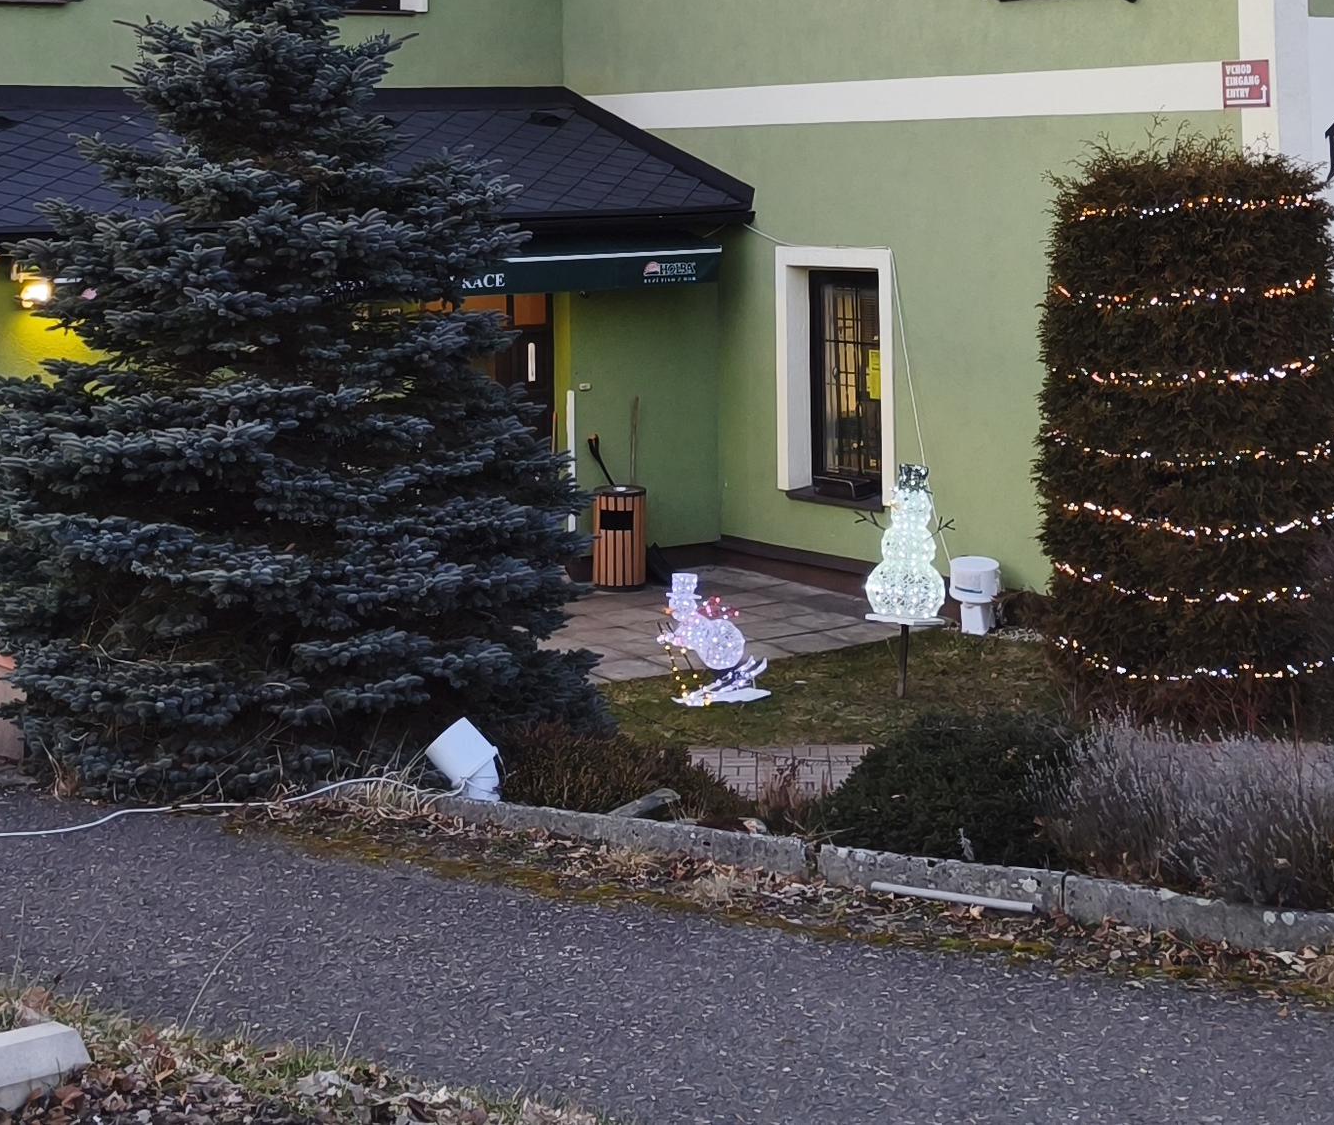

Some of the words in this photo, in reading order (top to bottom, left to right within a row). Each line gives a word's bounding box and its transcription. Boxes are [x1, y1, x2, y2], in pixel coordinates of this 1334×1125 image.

[1225, 64, 1252, 75] VCHOD
[1225, 74, 1260, 87] EINGANG
[1225, 87, 1250, 99] ENTRY
[659, 261, 697, 275] HOLBA
